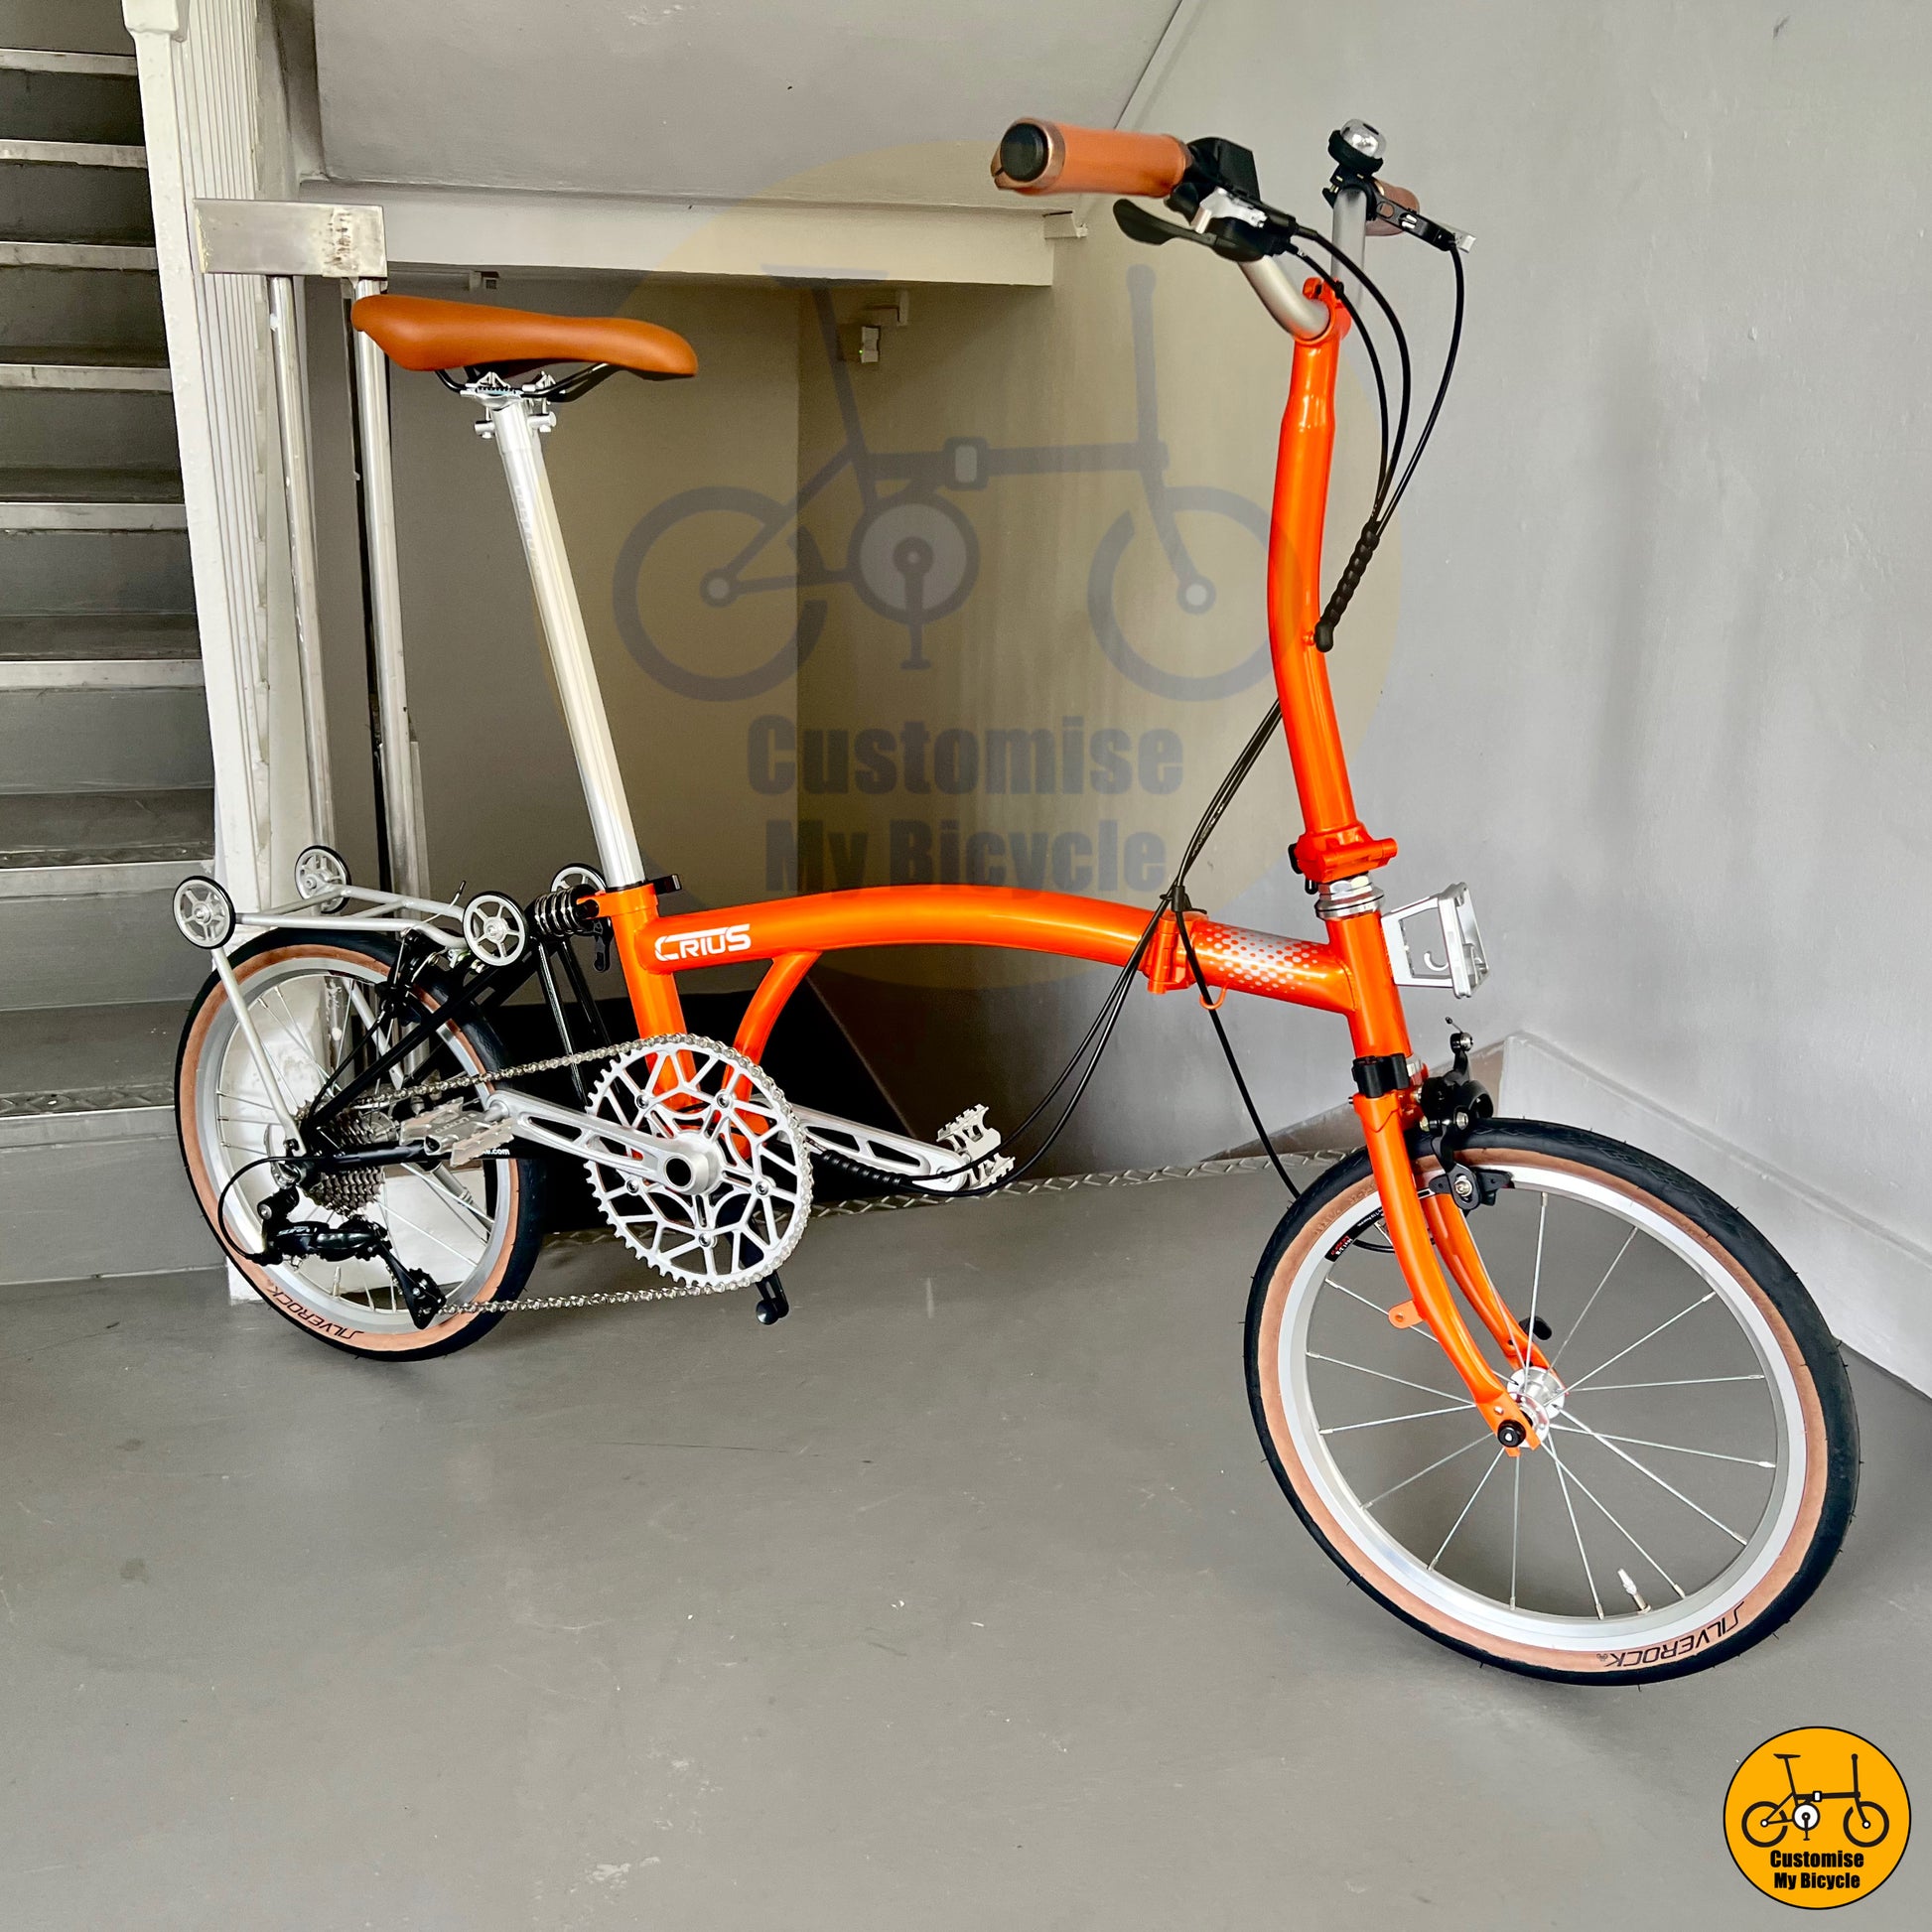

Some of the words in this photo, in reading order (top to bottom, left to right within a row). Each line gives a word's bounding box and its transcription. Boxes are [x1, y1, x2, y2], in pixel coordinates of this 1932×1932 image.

[654, 923, 752, 962] CRIUS
[267, 1286, 364, 1339] SILVEROCK
[1605, 1600, 1744, 1667] SILVEROCK
